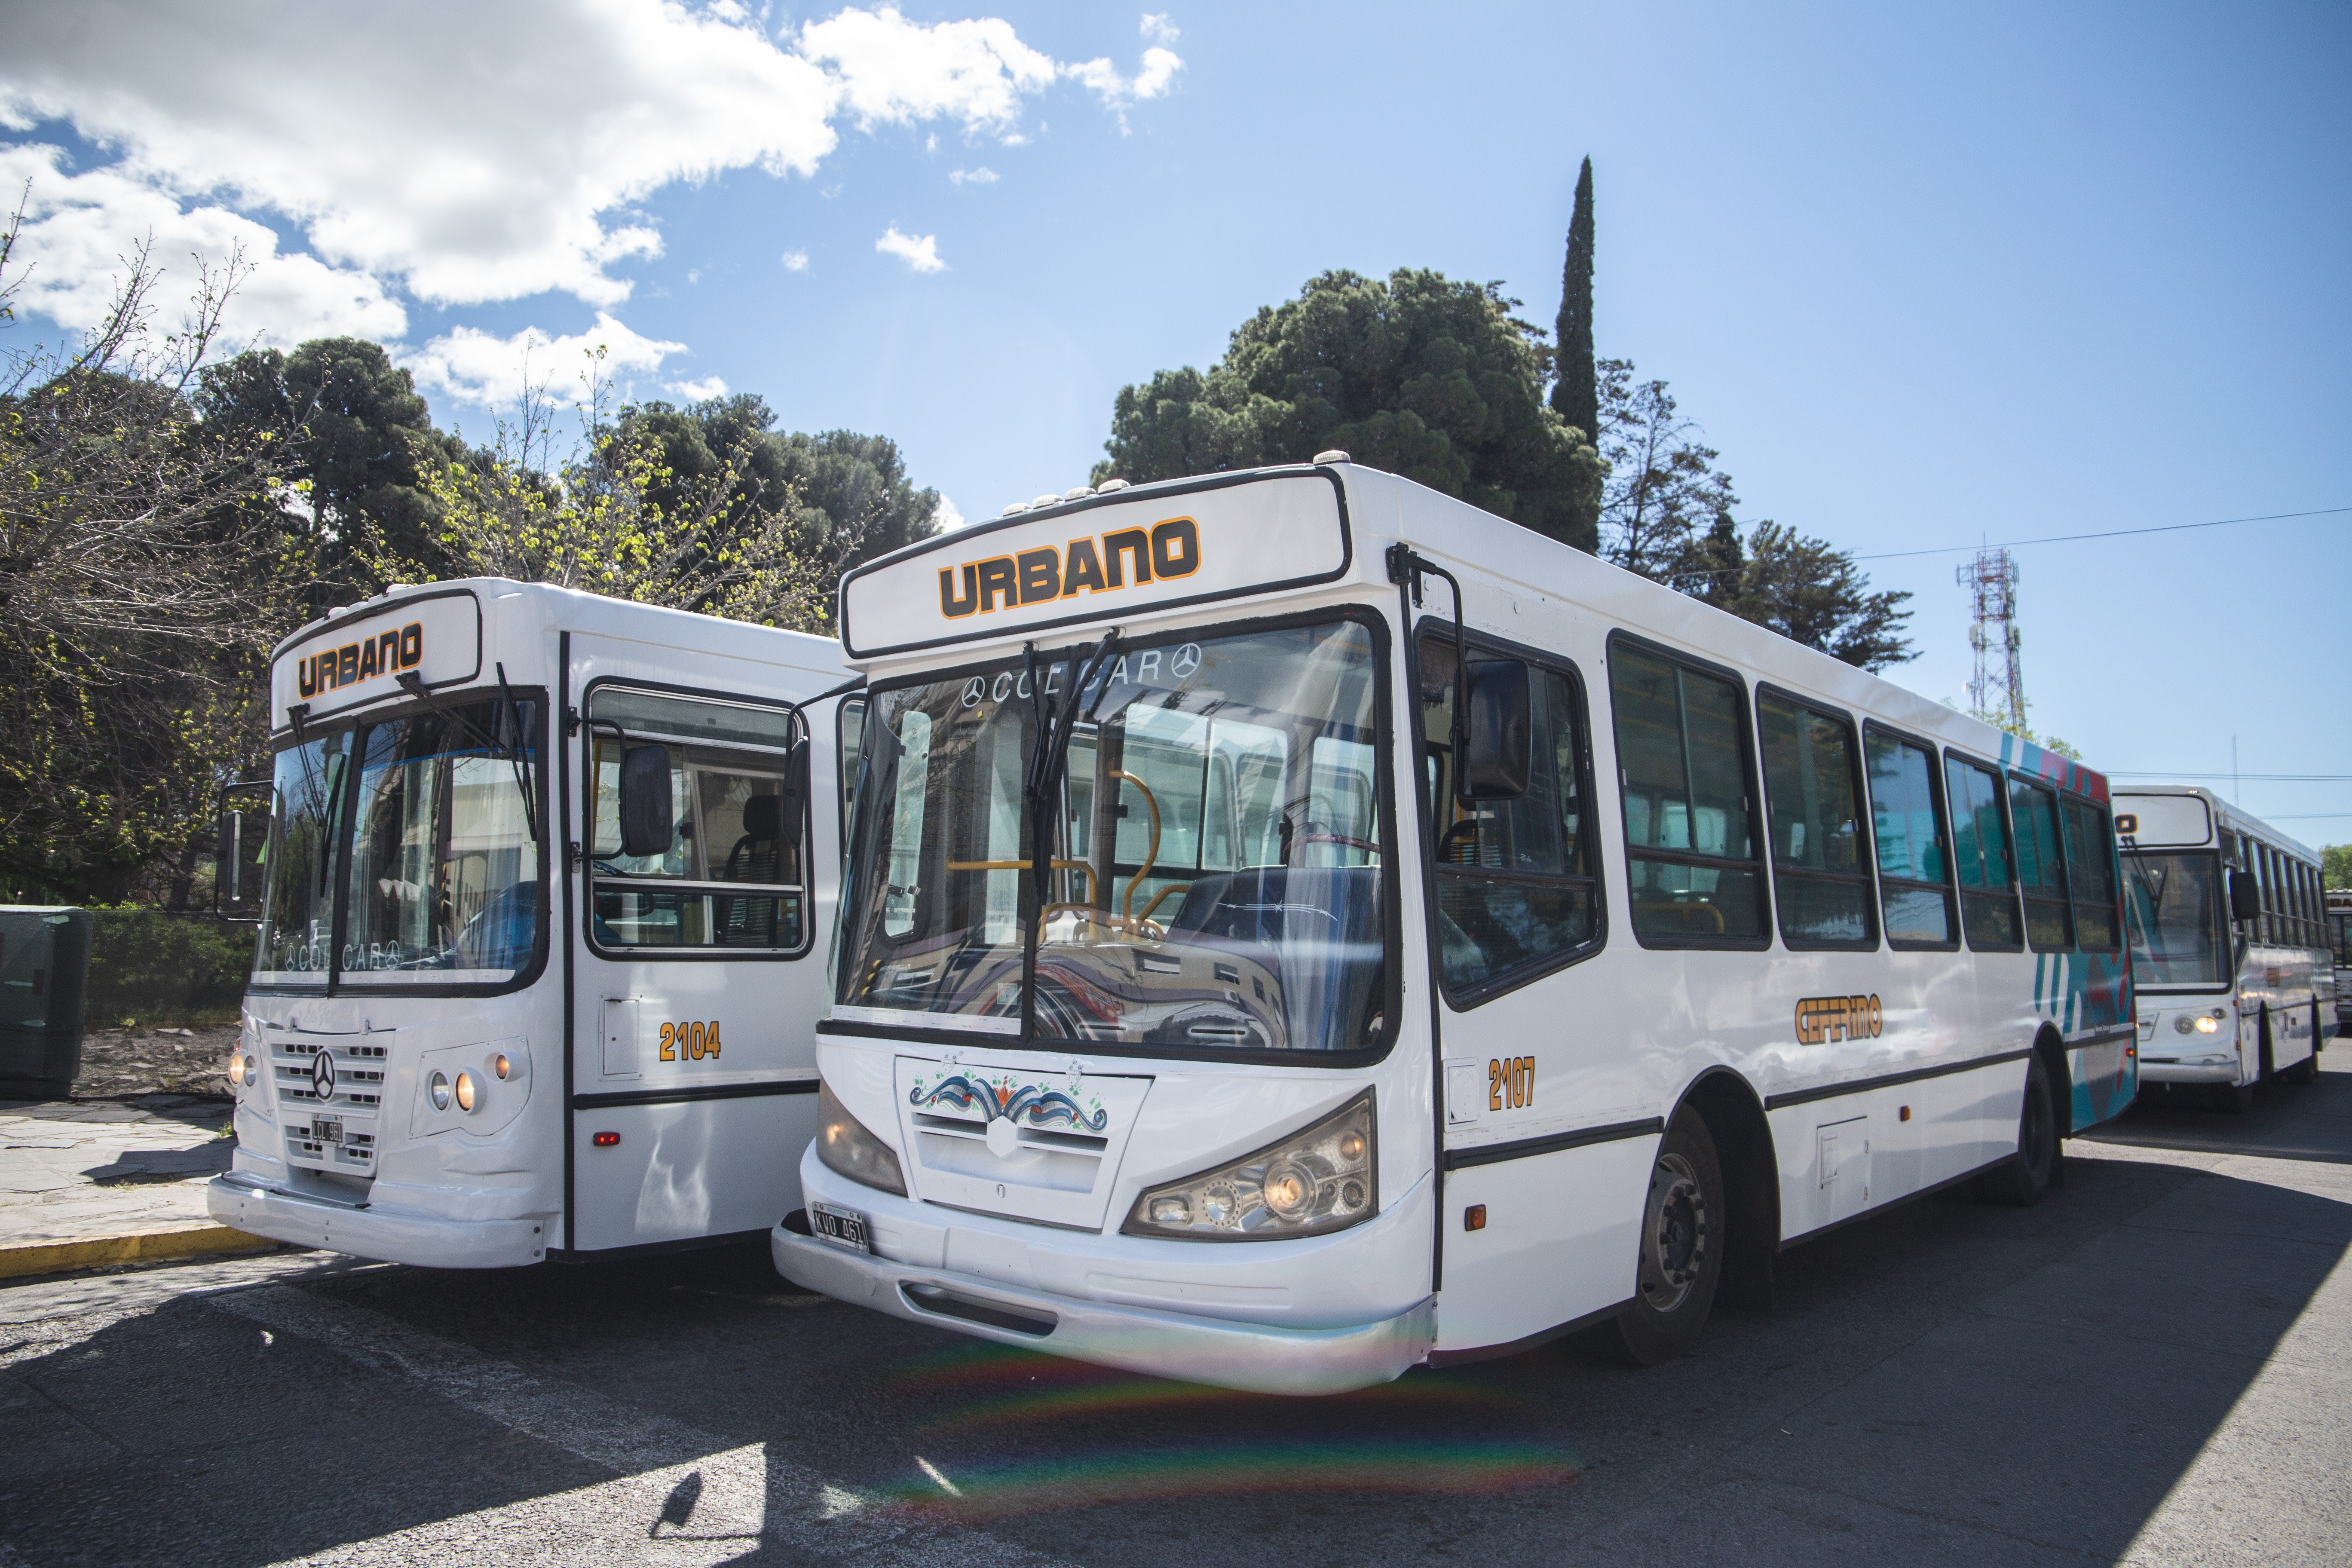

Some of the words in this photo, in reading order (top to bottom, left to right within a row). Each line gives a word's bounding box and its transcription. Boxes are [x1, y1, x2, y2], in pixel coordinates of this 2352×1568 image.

[938, 515, 1202, 620] URBANO
[298, 621, 423, 700] URBANO
[343, 943, 380, 971] CAR
[660, 1021, 721, 1062] 2104
[1795, 993, 1883, 1046] CEFERINO
[1489, 1056, 1535, 1112] 2107
[313, 1121, 326, 1139] LCL
[329, 1123, 342, 1142] 961
[815, 1212, 837, 1236] KVO
[842, 1219, 864, 1244] 461
